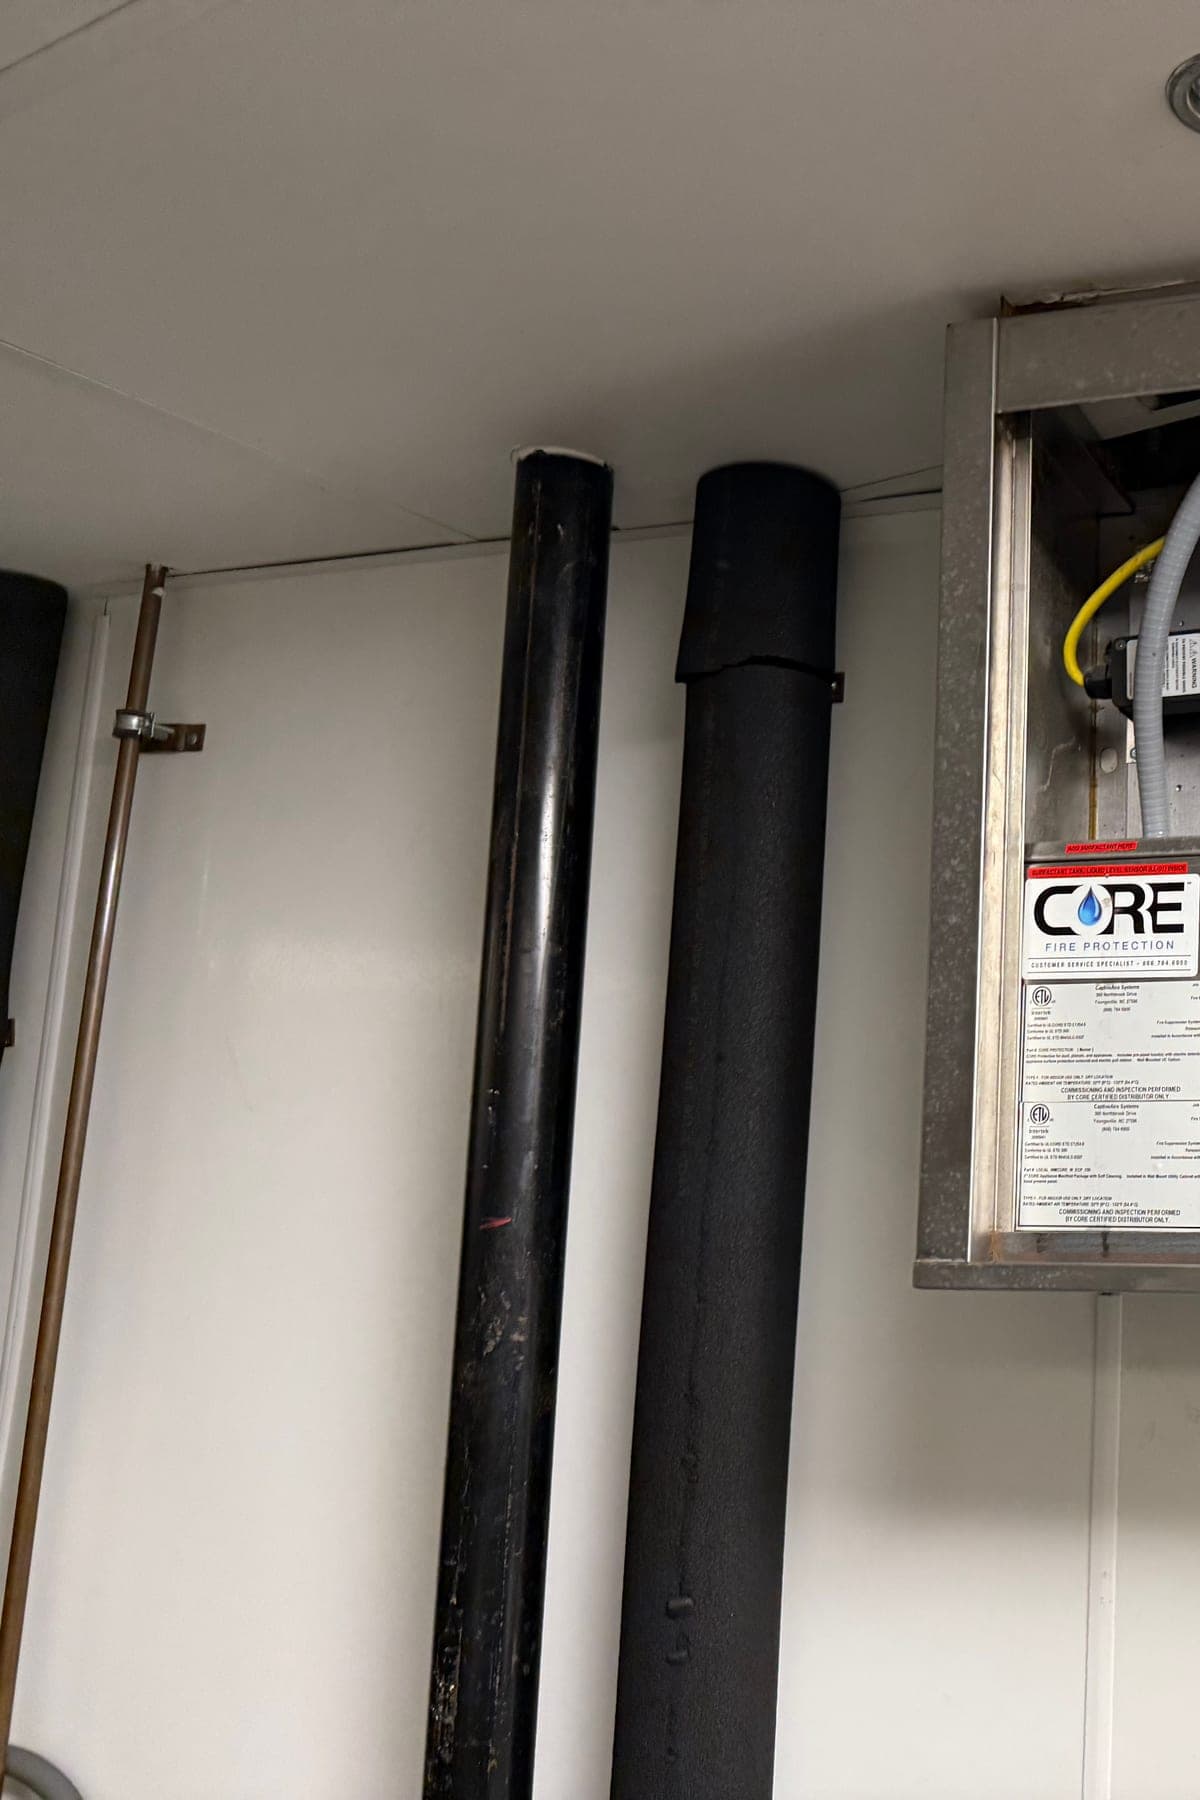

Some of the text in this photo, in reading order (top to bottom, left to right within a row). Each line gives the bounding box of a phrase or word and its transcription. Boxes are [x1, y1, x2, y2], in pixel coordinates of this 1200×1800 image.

[1034, 882, 1185, 936] CORE
[1046, 940, 1174, 952] FIRE PROTECTION
